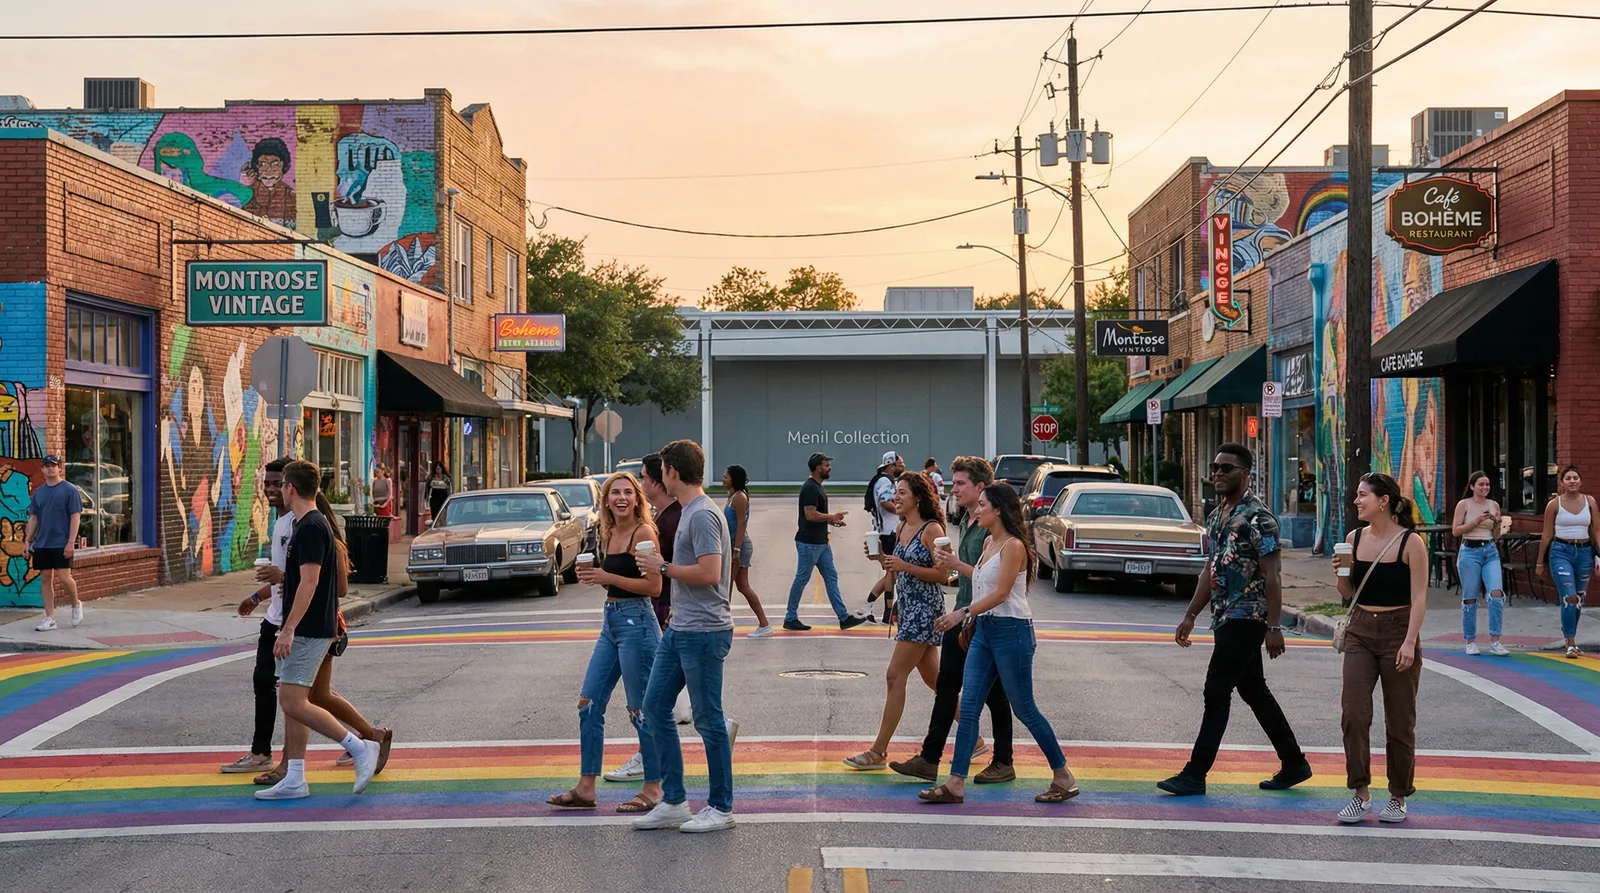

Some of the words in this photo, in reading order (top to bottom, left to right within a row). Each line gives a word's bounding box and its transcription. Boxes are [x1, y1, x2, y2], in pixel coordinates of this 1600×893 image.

[1423, 186, 1460, 210] Café
[1401, 208, 1483, 227] BOHÈME
[1409, 230, 1474, 238] RESTAURANT
[1214, 216, 1230, 304] VINGGE
[195, 270, 319, 291] MONTROSE
[209, 295, 305, 315] VINTAGE
[499, 318, 560, 337] Bohème
[1102, 327, 1166, 347] Montrose
[787, 430, 828, 444] Menil
[833, 430, 910, 444] Collection
[1033, 423, 1057, 434] STOP
